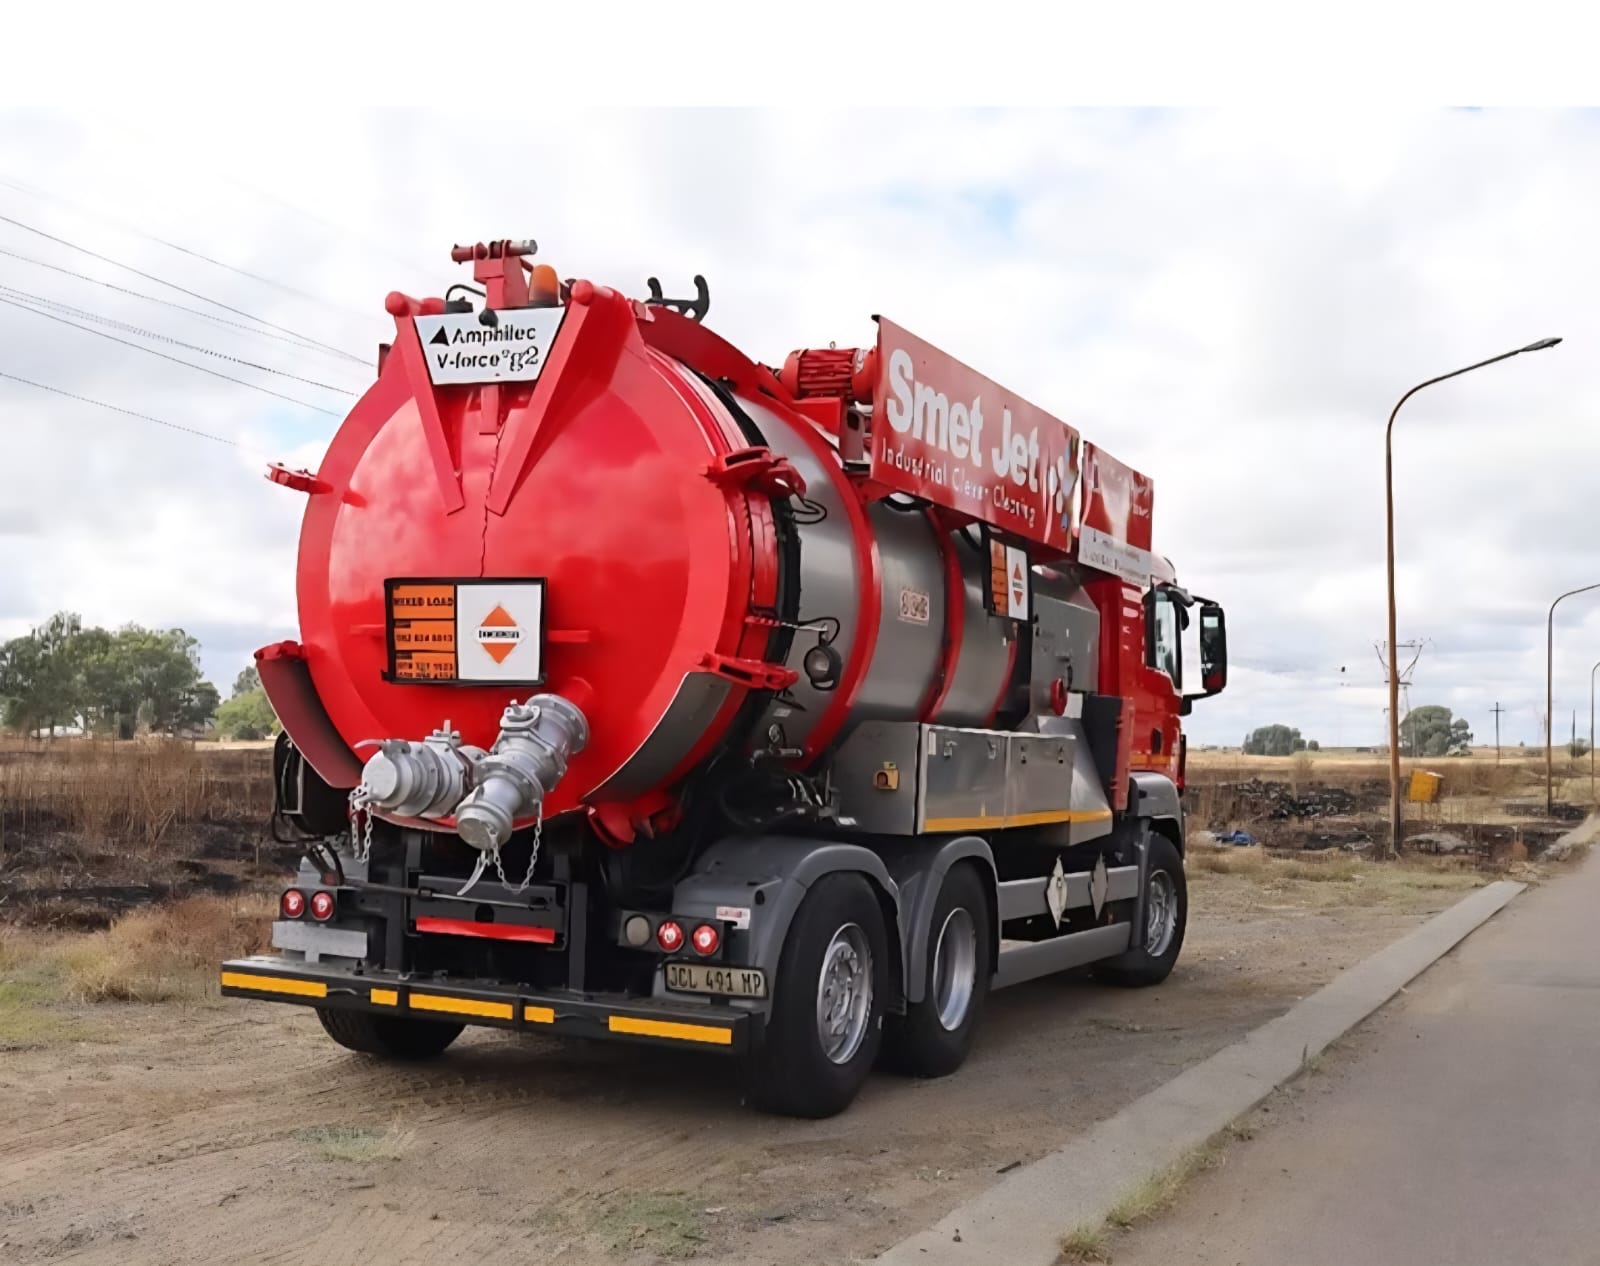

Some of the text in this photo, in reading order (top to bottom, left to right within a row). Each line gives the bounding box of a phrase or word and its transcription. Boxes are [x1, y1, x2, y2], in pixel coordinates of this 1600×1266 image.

[886, 349, 1040, 493] Smet Jet
[670, 966, 698, 989] JCL
[706, 969, 734, 992] 491
